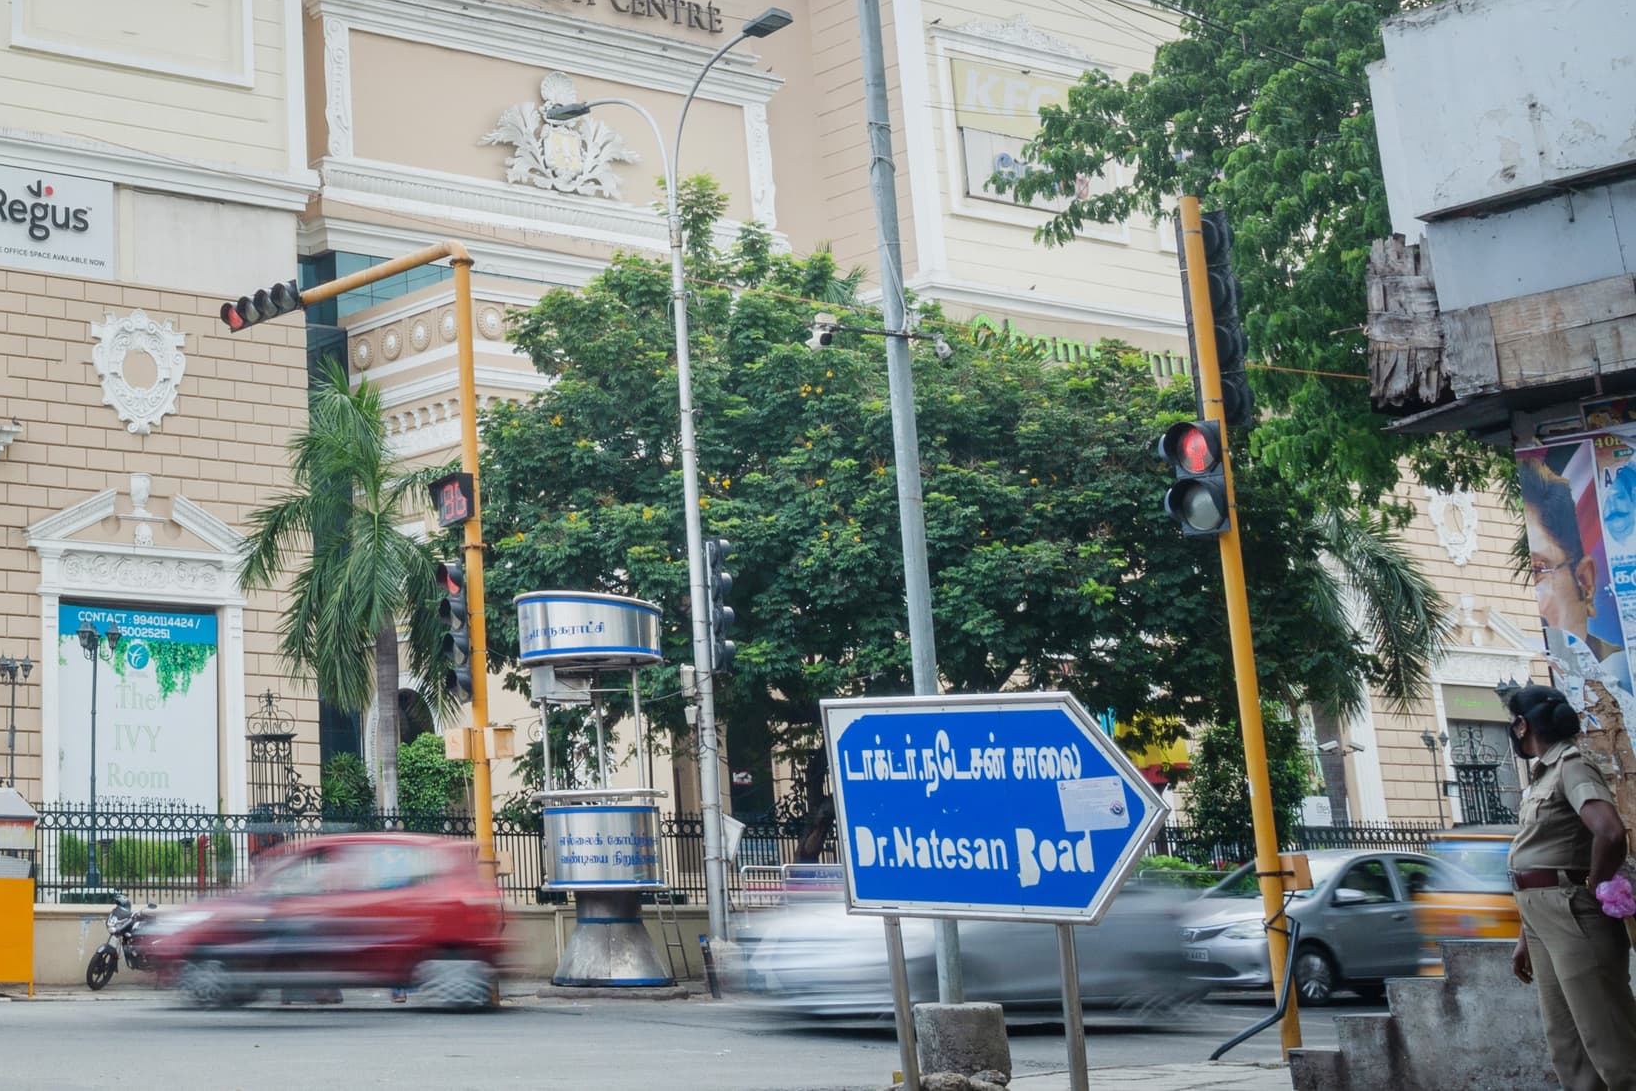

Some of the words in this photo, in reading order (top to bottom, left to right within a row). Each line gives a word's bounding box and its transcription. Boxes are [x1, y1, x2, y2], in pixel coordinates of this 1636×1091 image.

[966, 68, 1059, 123] KFC
[4, 246, 28, 257] OFFICE
[29, 250, 52, 260] SPACE
[52, 253, 88, 265] AVAILABLE
[78, 611, 126, 624] CONTACT
[133, 615, 194, 628] 9940114424
[115, 682, 157, 711] The
[114, 724, 163, 753] IVY
[107, 762, 170, 789] Room
